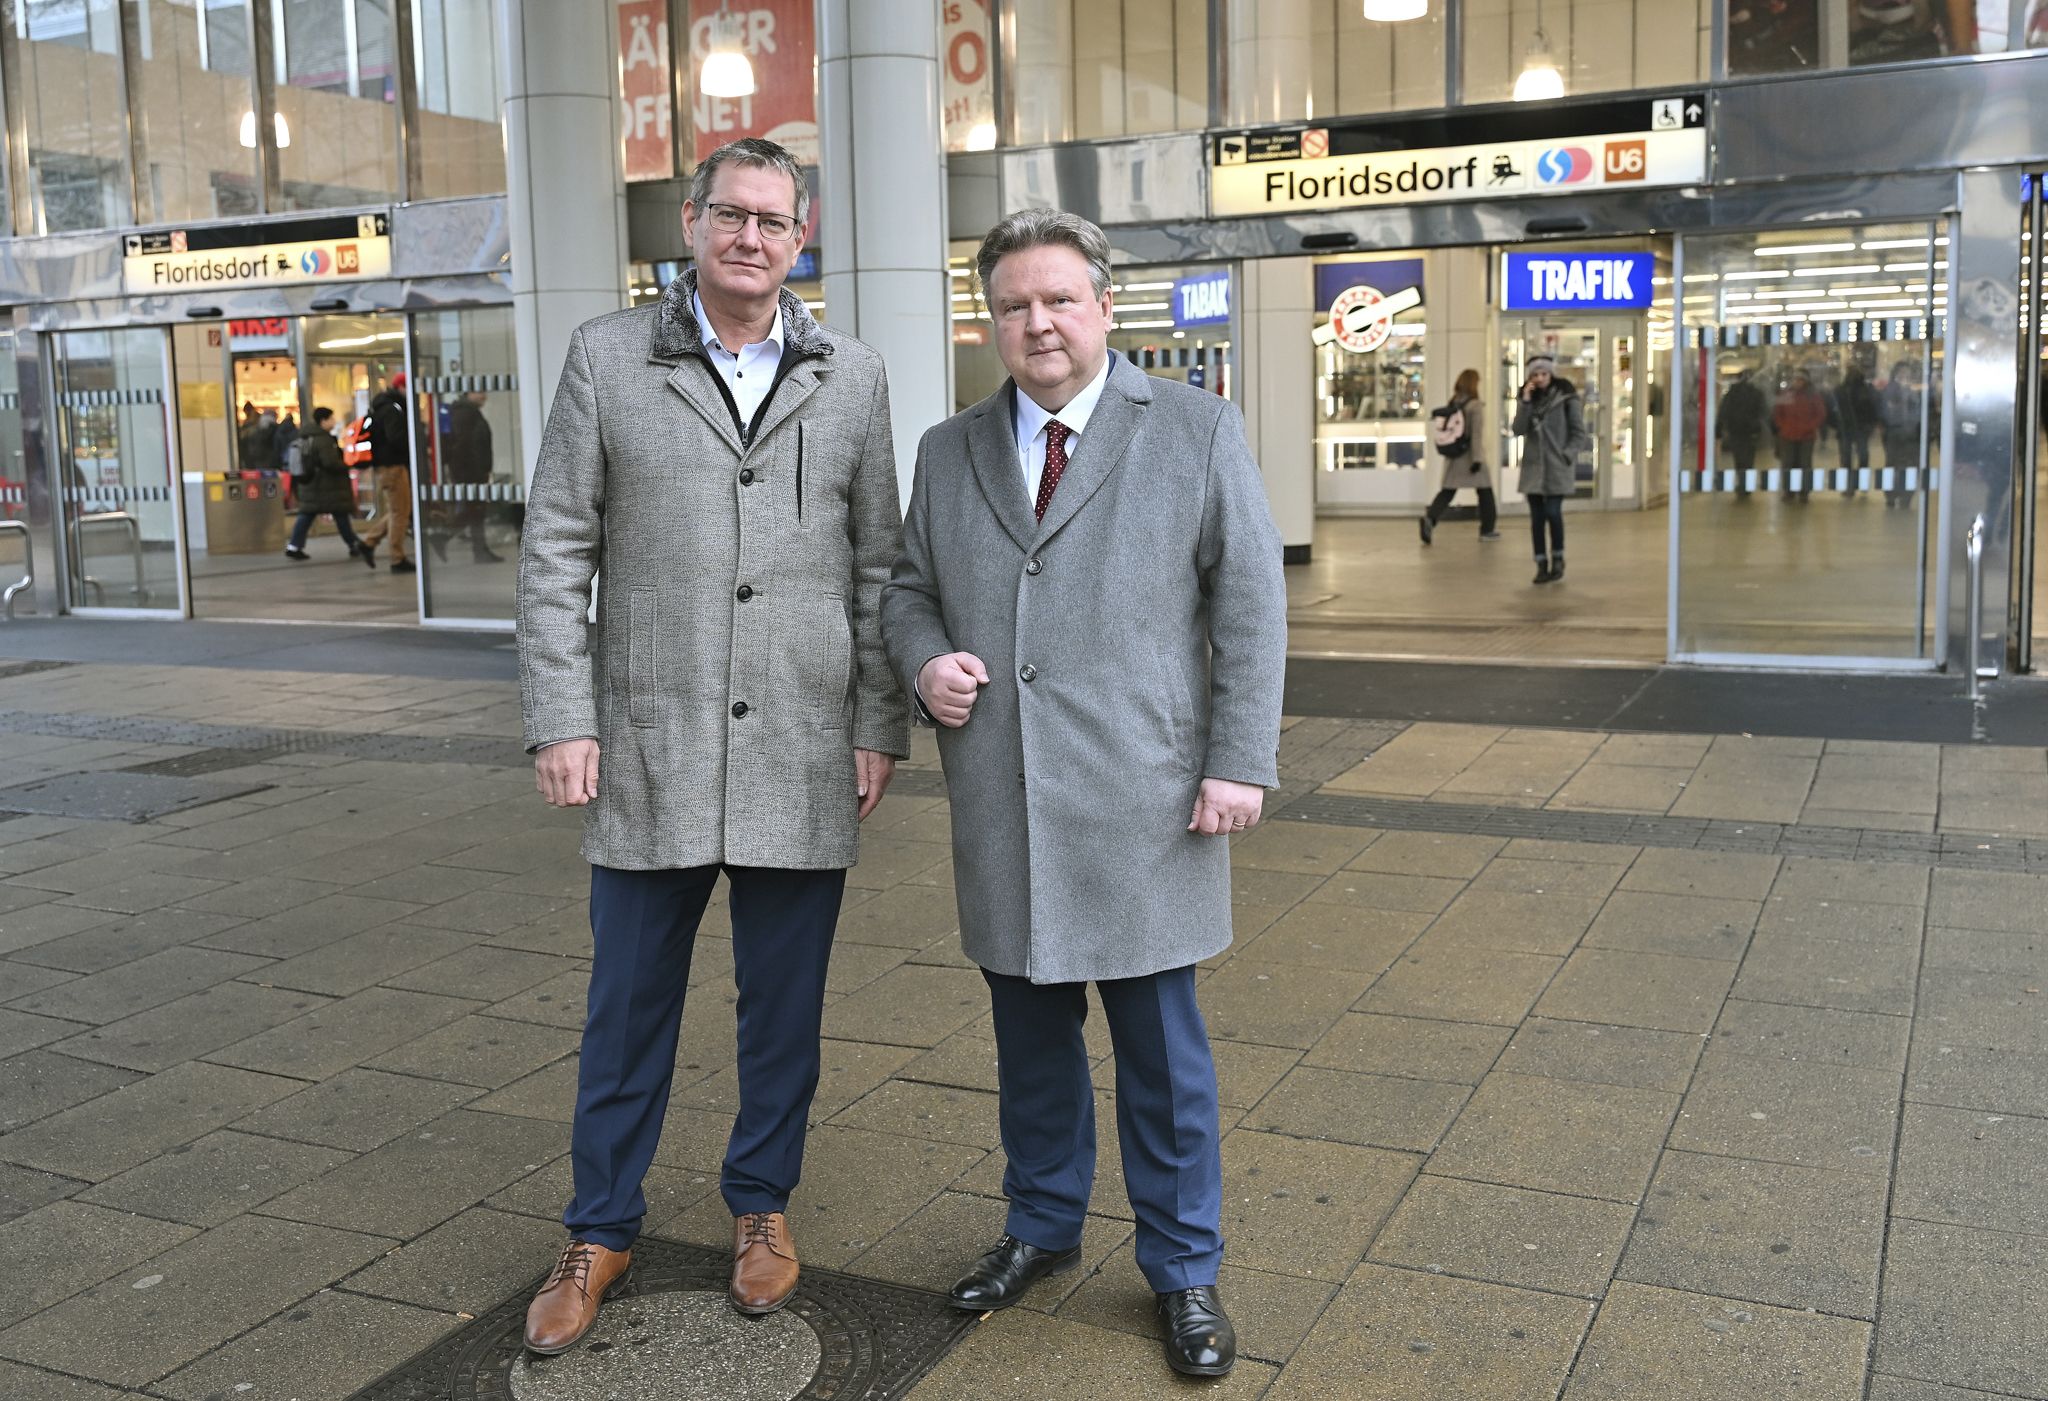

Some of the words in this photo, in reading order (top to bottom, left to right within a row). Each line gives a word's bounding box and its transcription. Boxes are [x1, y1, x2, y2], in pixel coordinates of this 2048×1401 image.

[1266, 156, 1478, 202] Floridsdorf
[1606, 148, 1643, 174] U6
[153, 254, 270, 285] Floridsdorf
[1527, 259, 1635, 301] TRAFIK
[1180, 278, 1229, 321] TABAK
